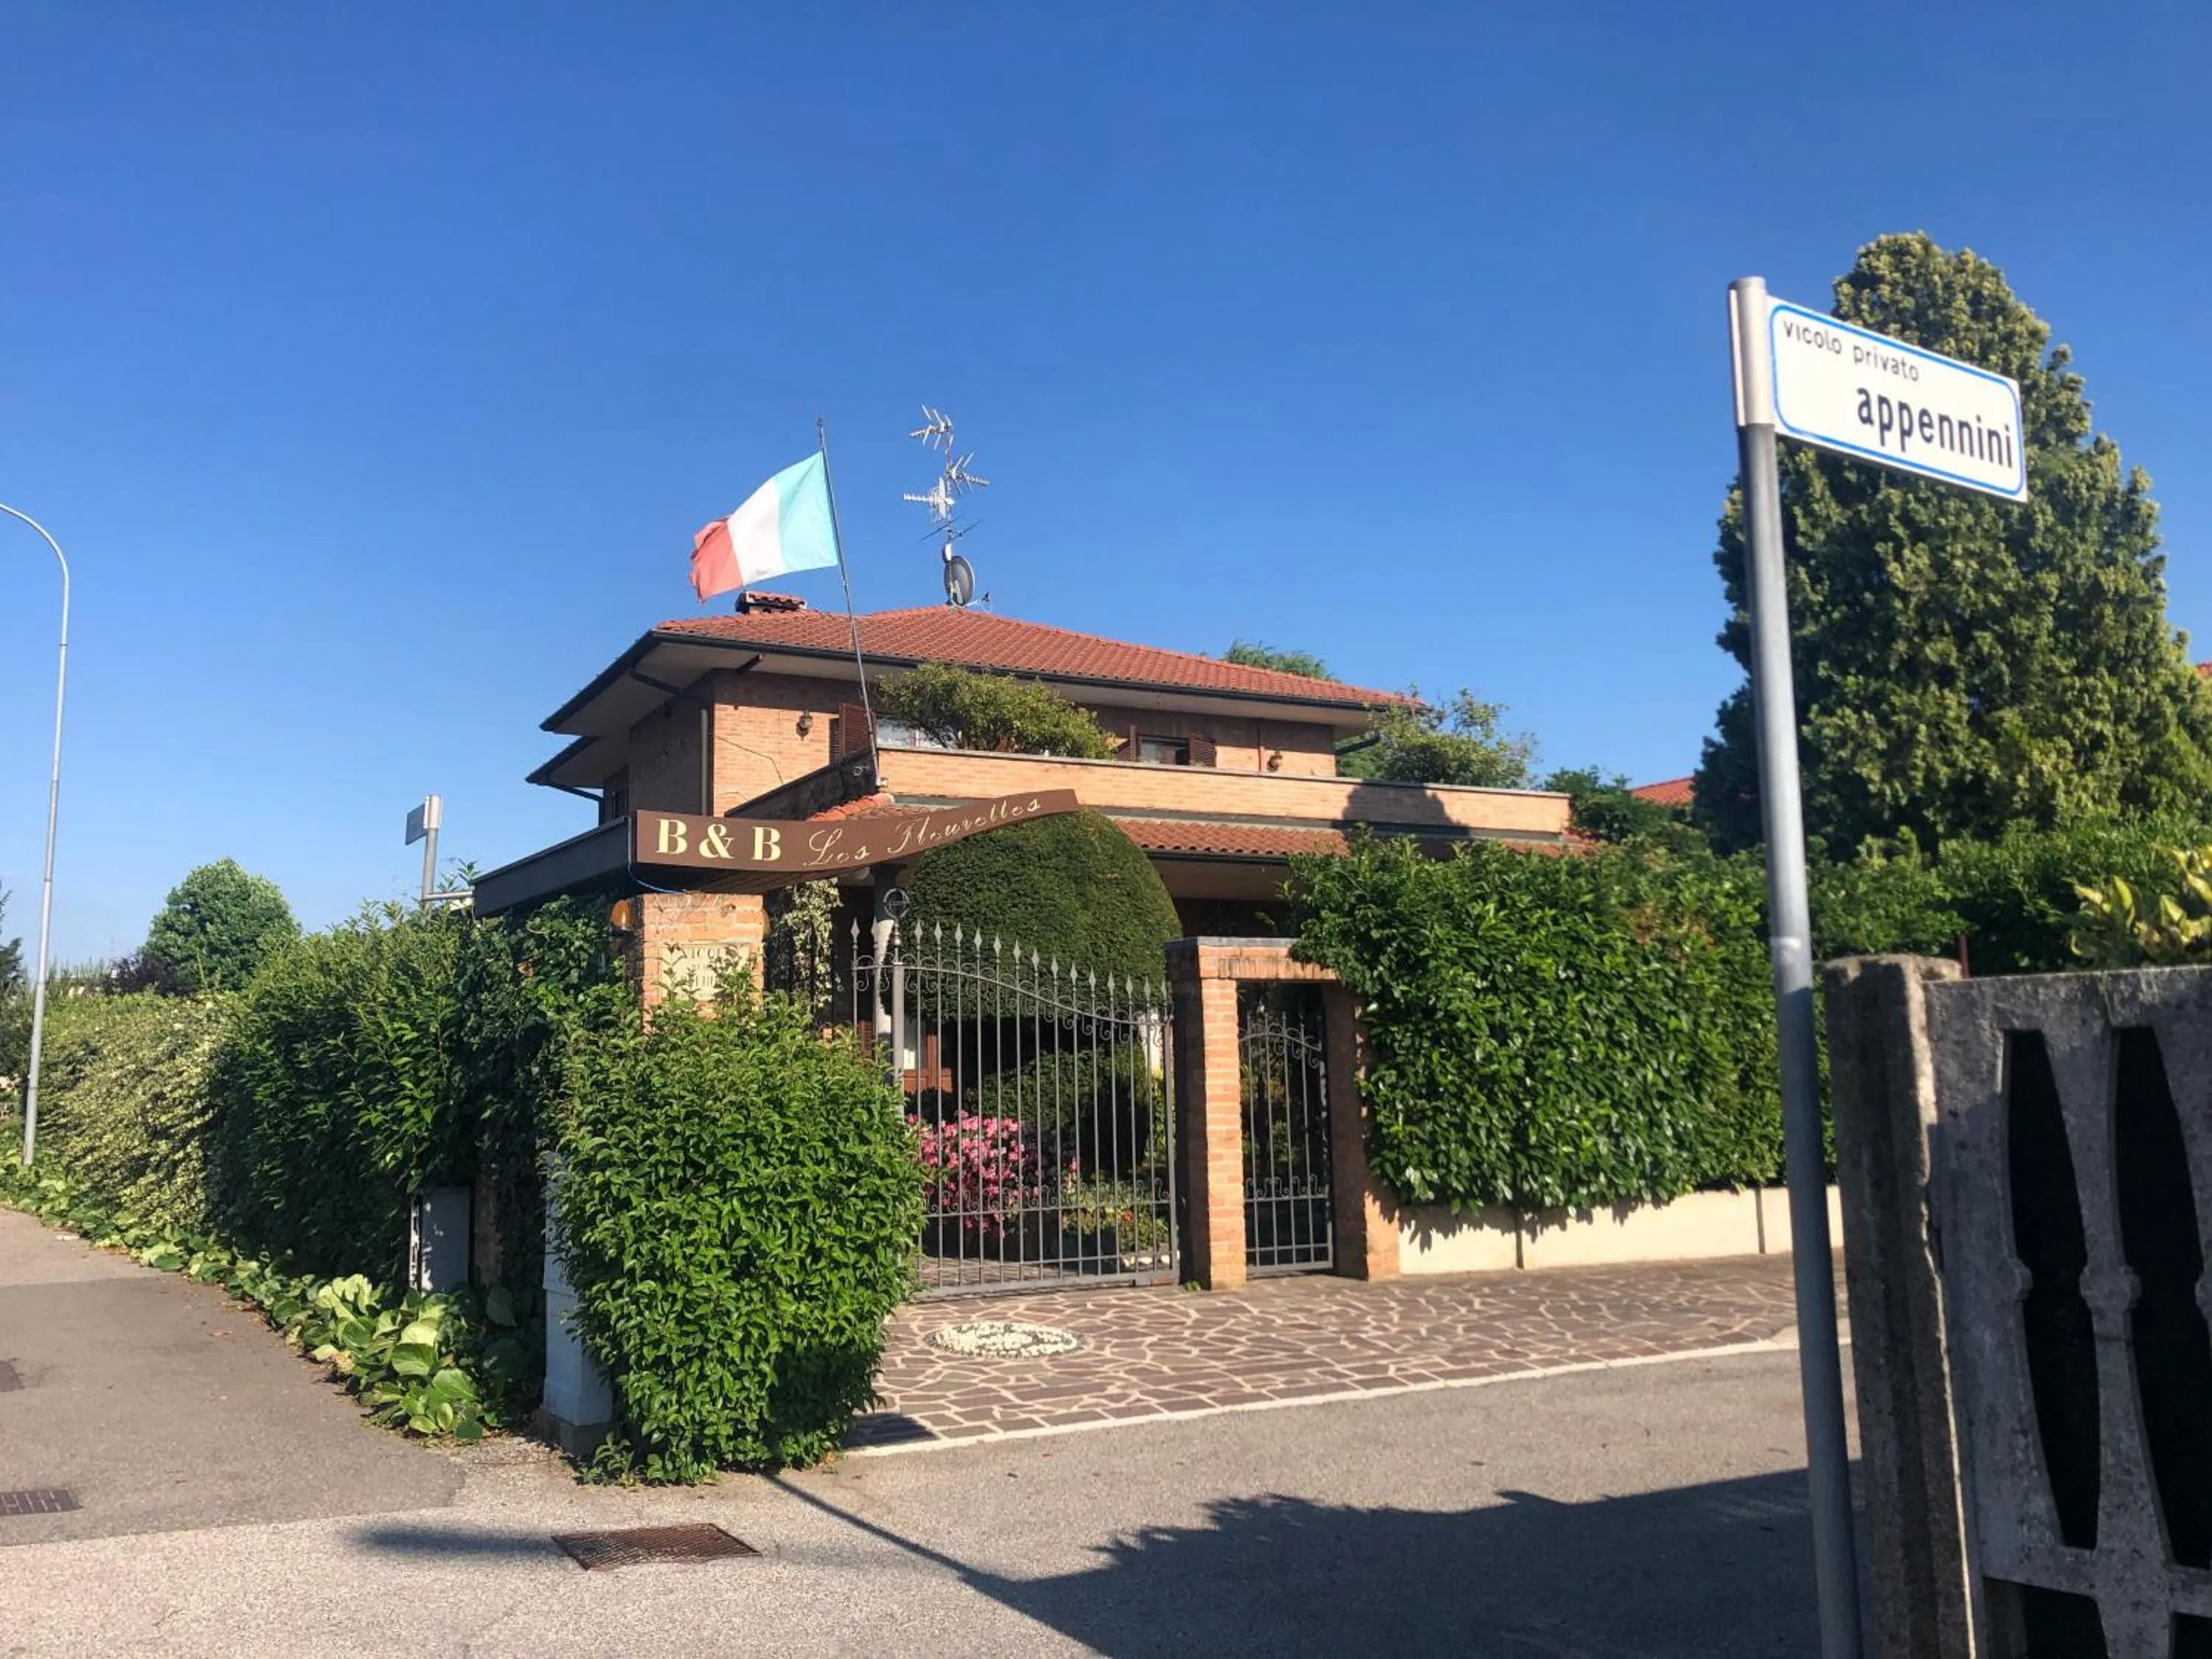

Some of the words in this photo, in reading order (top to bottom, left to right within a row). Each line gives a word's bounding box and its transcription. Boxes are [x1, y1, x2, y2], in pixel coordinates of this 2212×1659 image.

[1783, 321, 1843, 355] vicolo
[1853, 344, 1919, 381] privato
[1857, 387, 2013, 468] appennini
[655, 818, 689, 855] B
[698, 824, 736, 859] &
[751, 827, 782, 861] B
[802, 828, 871, 866] Les
